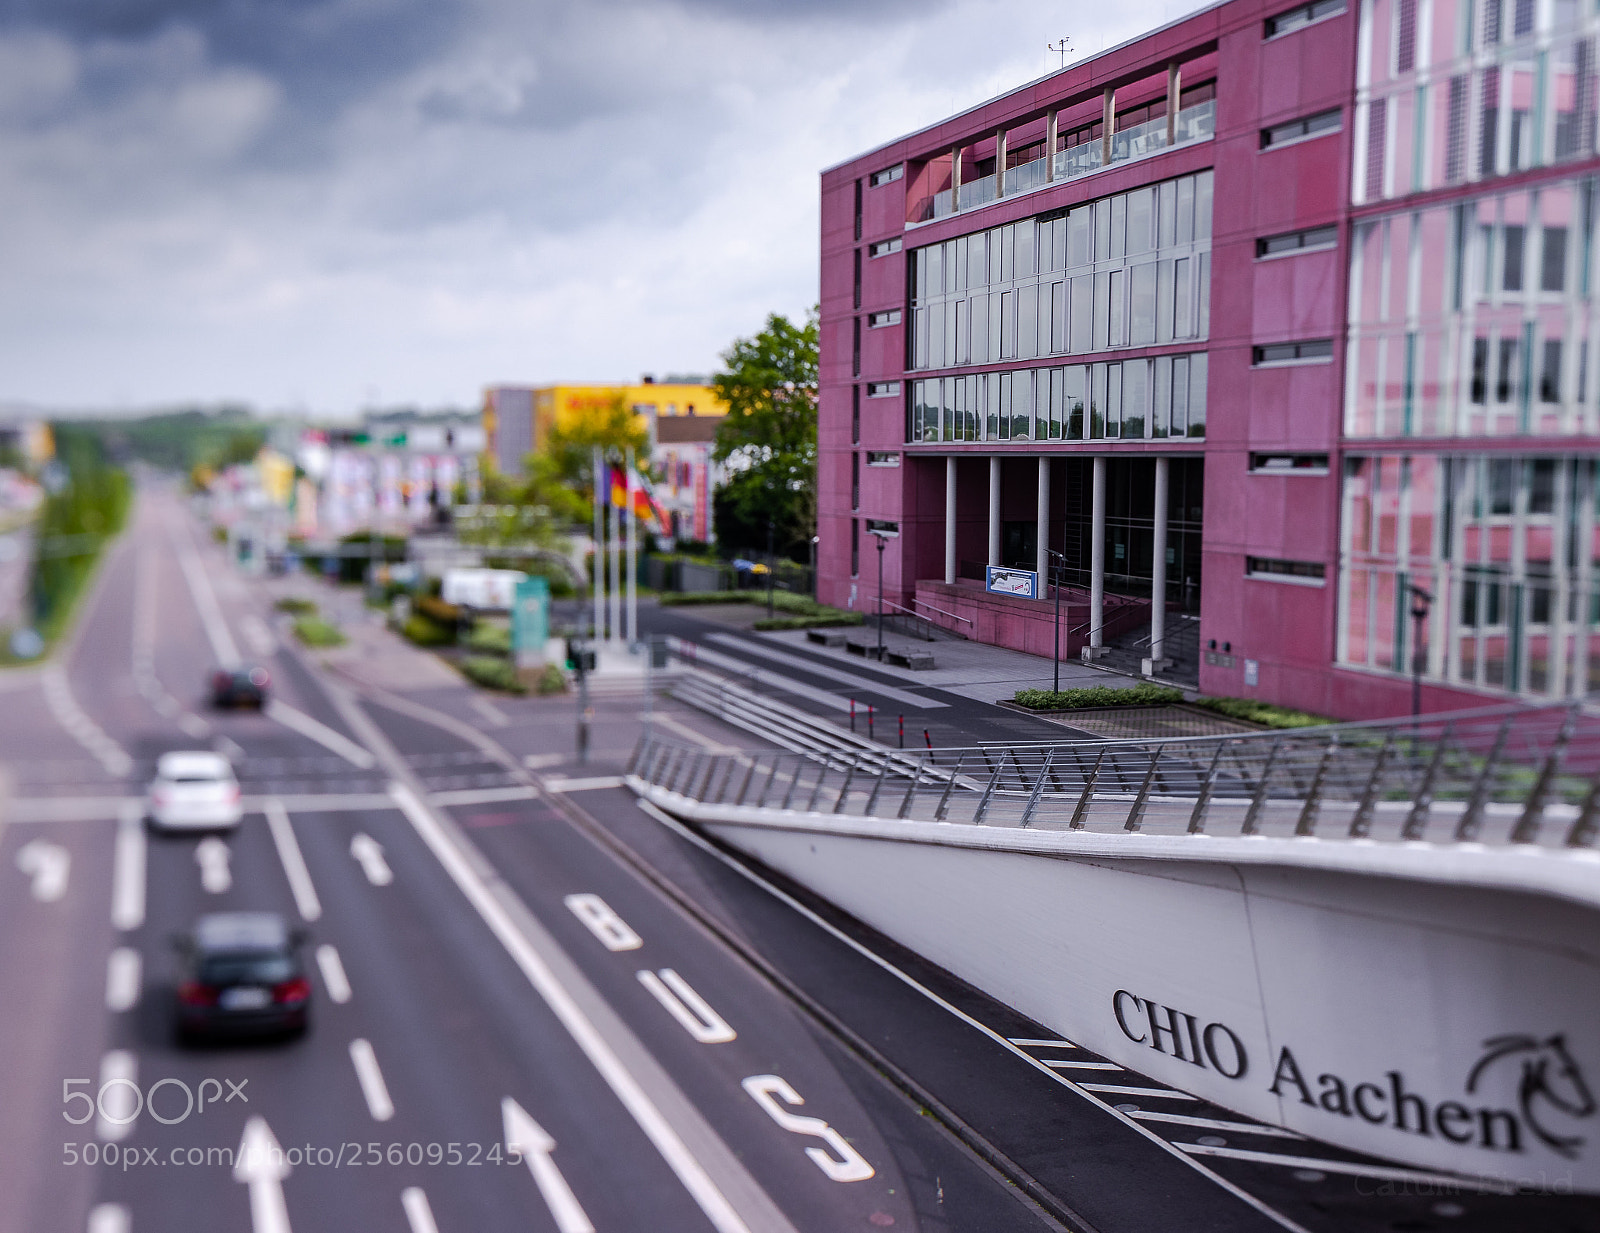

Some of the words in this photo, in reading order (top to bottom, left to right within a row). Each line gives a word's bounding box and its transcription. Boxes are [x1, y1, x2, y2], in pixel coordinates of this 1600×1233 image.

[563, 893, 875, 1182] BUS
[1112, 989, 1248, 1079] CHIO
[1270, 1047, 1521, 1152] Aachen
